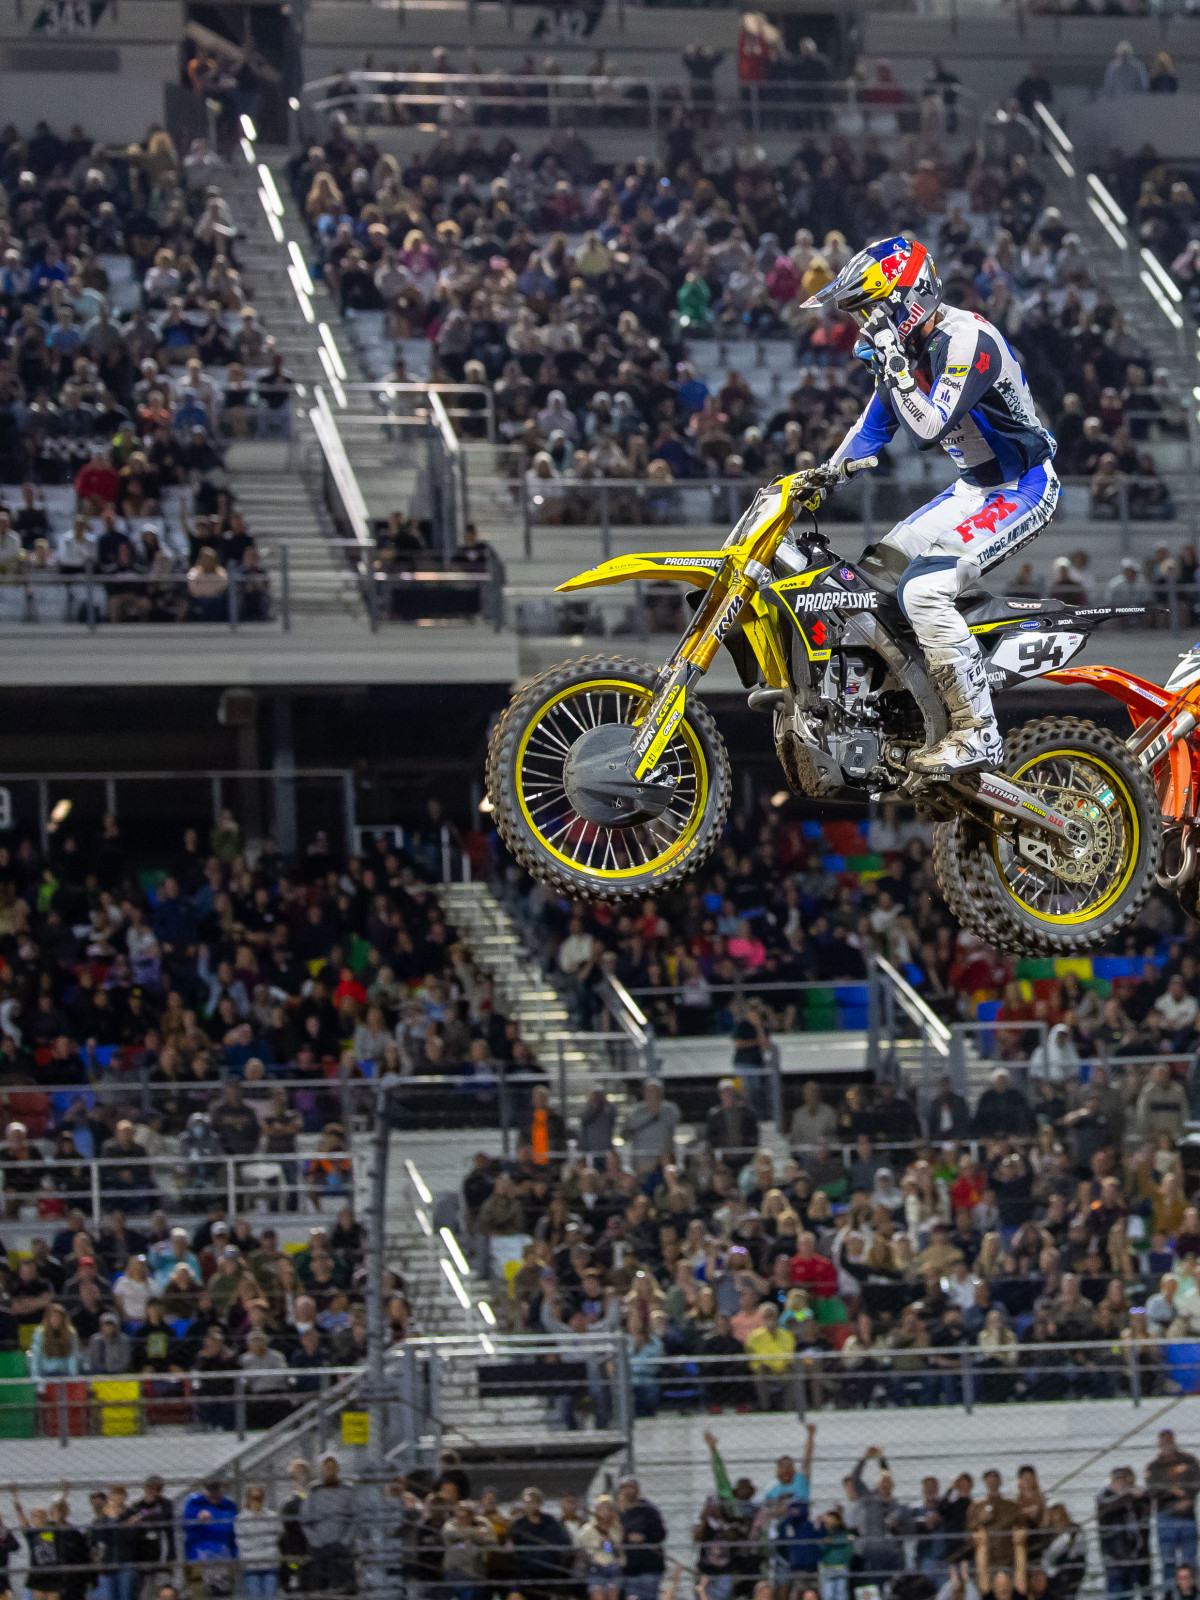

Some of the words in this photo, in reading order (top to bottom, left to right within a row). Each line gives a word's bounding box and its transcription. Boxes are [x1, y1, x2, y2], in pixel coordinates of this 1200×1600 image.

[664, 557, 721, 568] PROGRESSIVE
[1018, 635, 1064, 673] 94
[979, 781, 1019, 803] ENTHAL
[1022, 801, 1047, 817] HINSON
